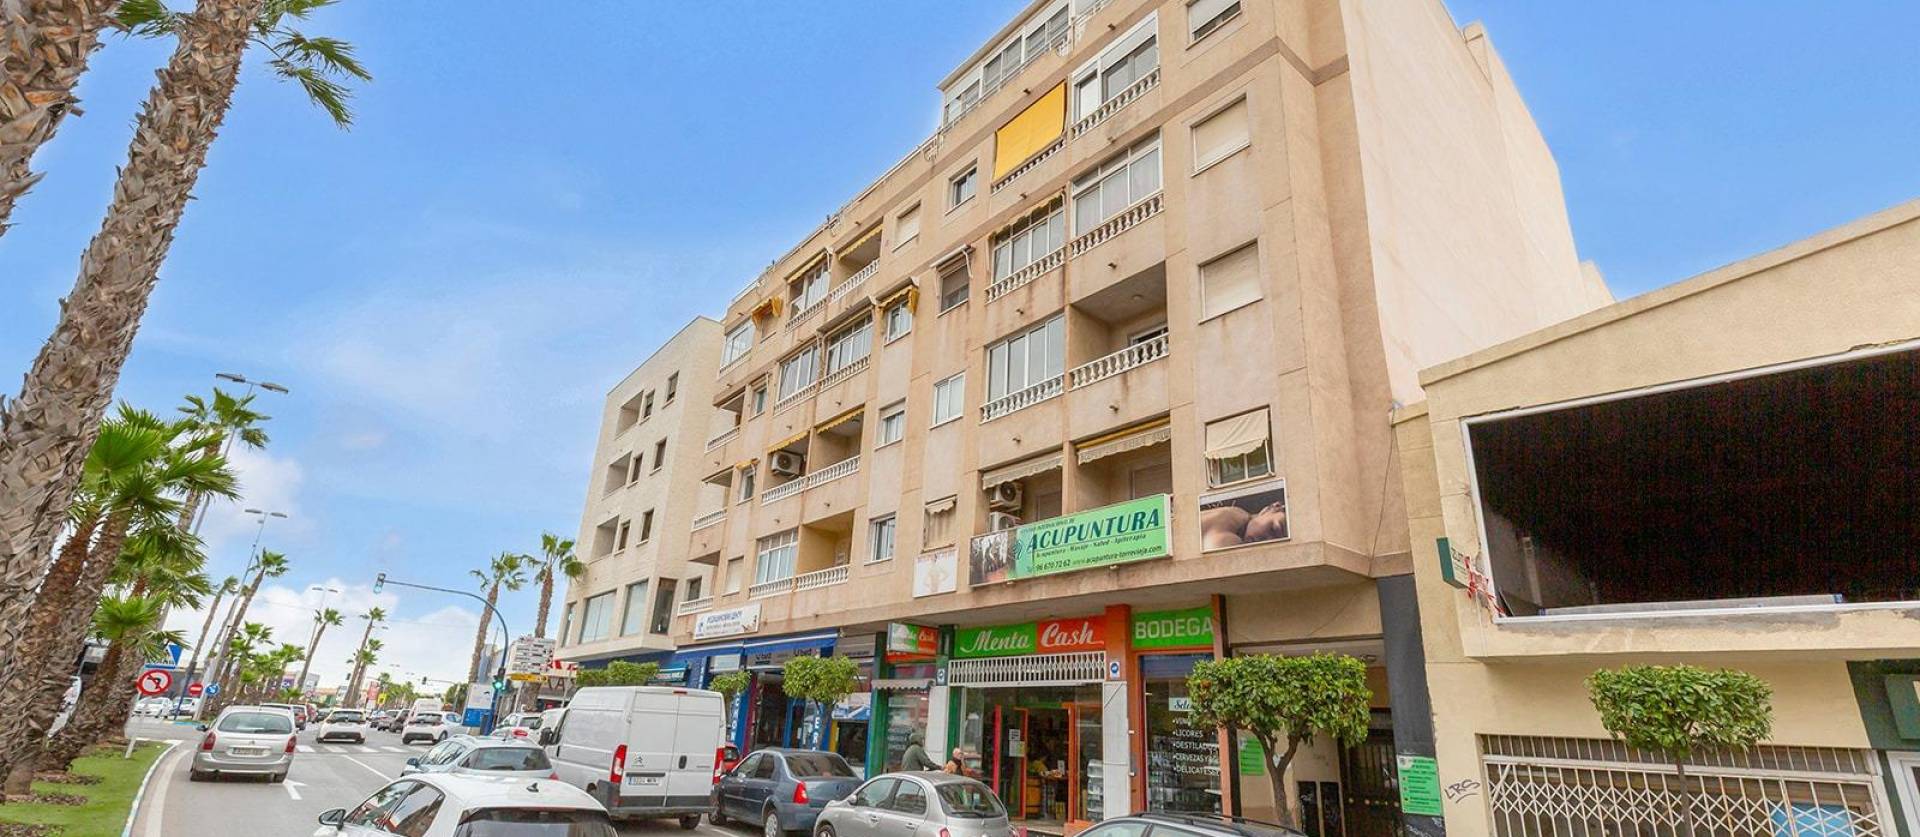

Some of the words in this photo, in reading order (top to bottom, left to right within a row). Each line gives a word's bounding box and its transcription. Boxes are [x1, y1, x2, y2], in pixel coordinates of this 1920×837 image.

[1026, 508, 1159, 550] ACUPUNTURA
[960, 630, 1030, 653] Menta
[1040, 621, 1104, 648] Cash
[1135, 616, 1214, 639] BODEGA
[1176, 729, 1204, 738] LICORES
